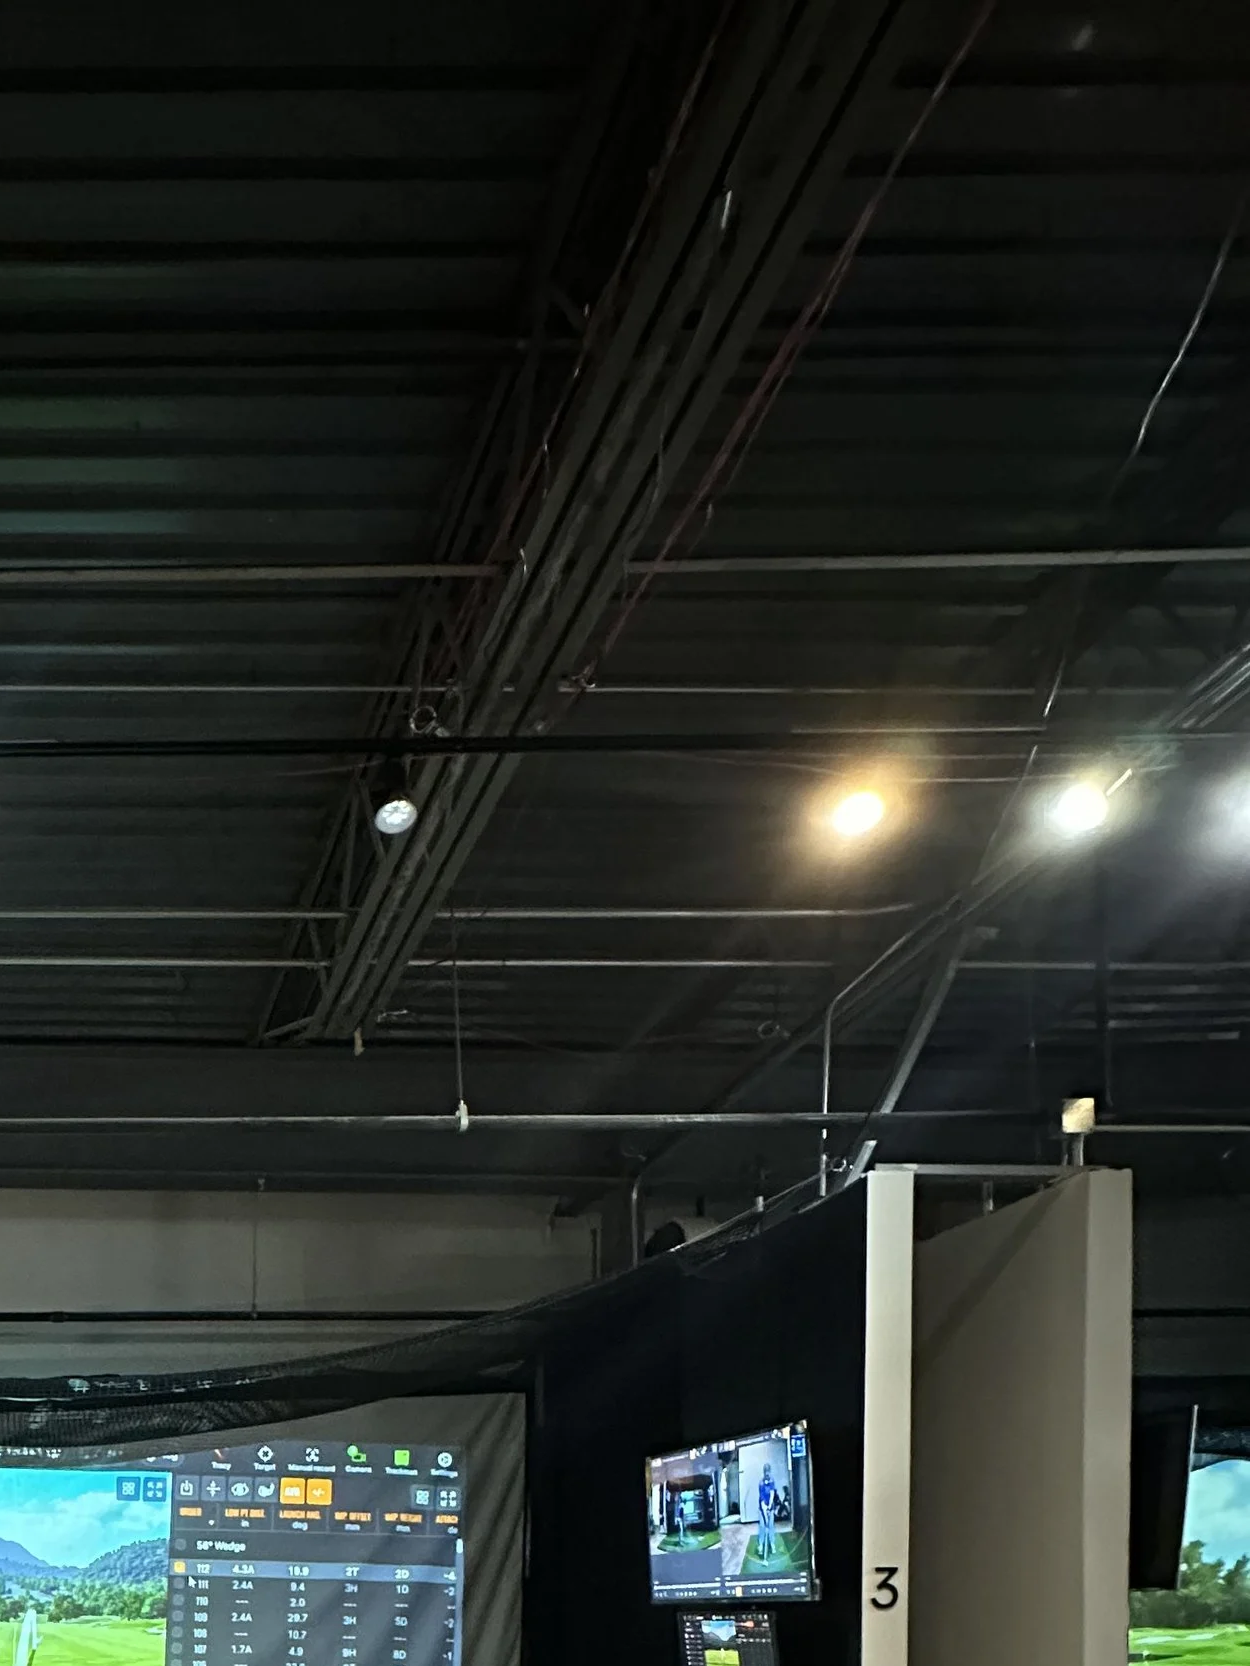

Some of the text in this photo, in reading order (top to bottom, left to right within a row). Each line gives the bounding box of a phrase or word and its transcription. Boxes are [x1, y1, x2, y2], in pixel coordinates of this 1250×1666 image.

[232, 1580, 254, 1590] 2.4A
[870, 1567, 899, 1611] 3
[231, 1612, 253, 1622] 2.4A
[231, 1644, 253, 1654] 1.7A
